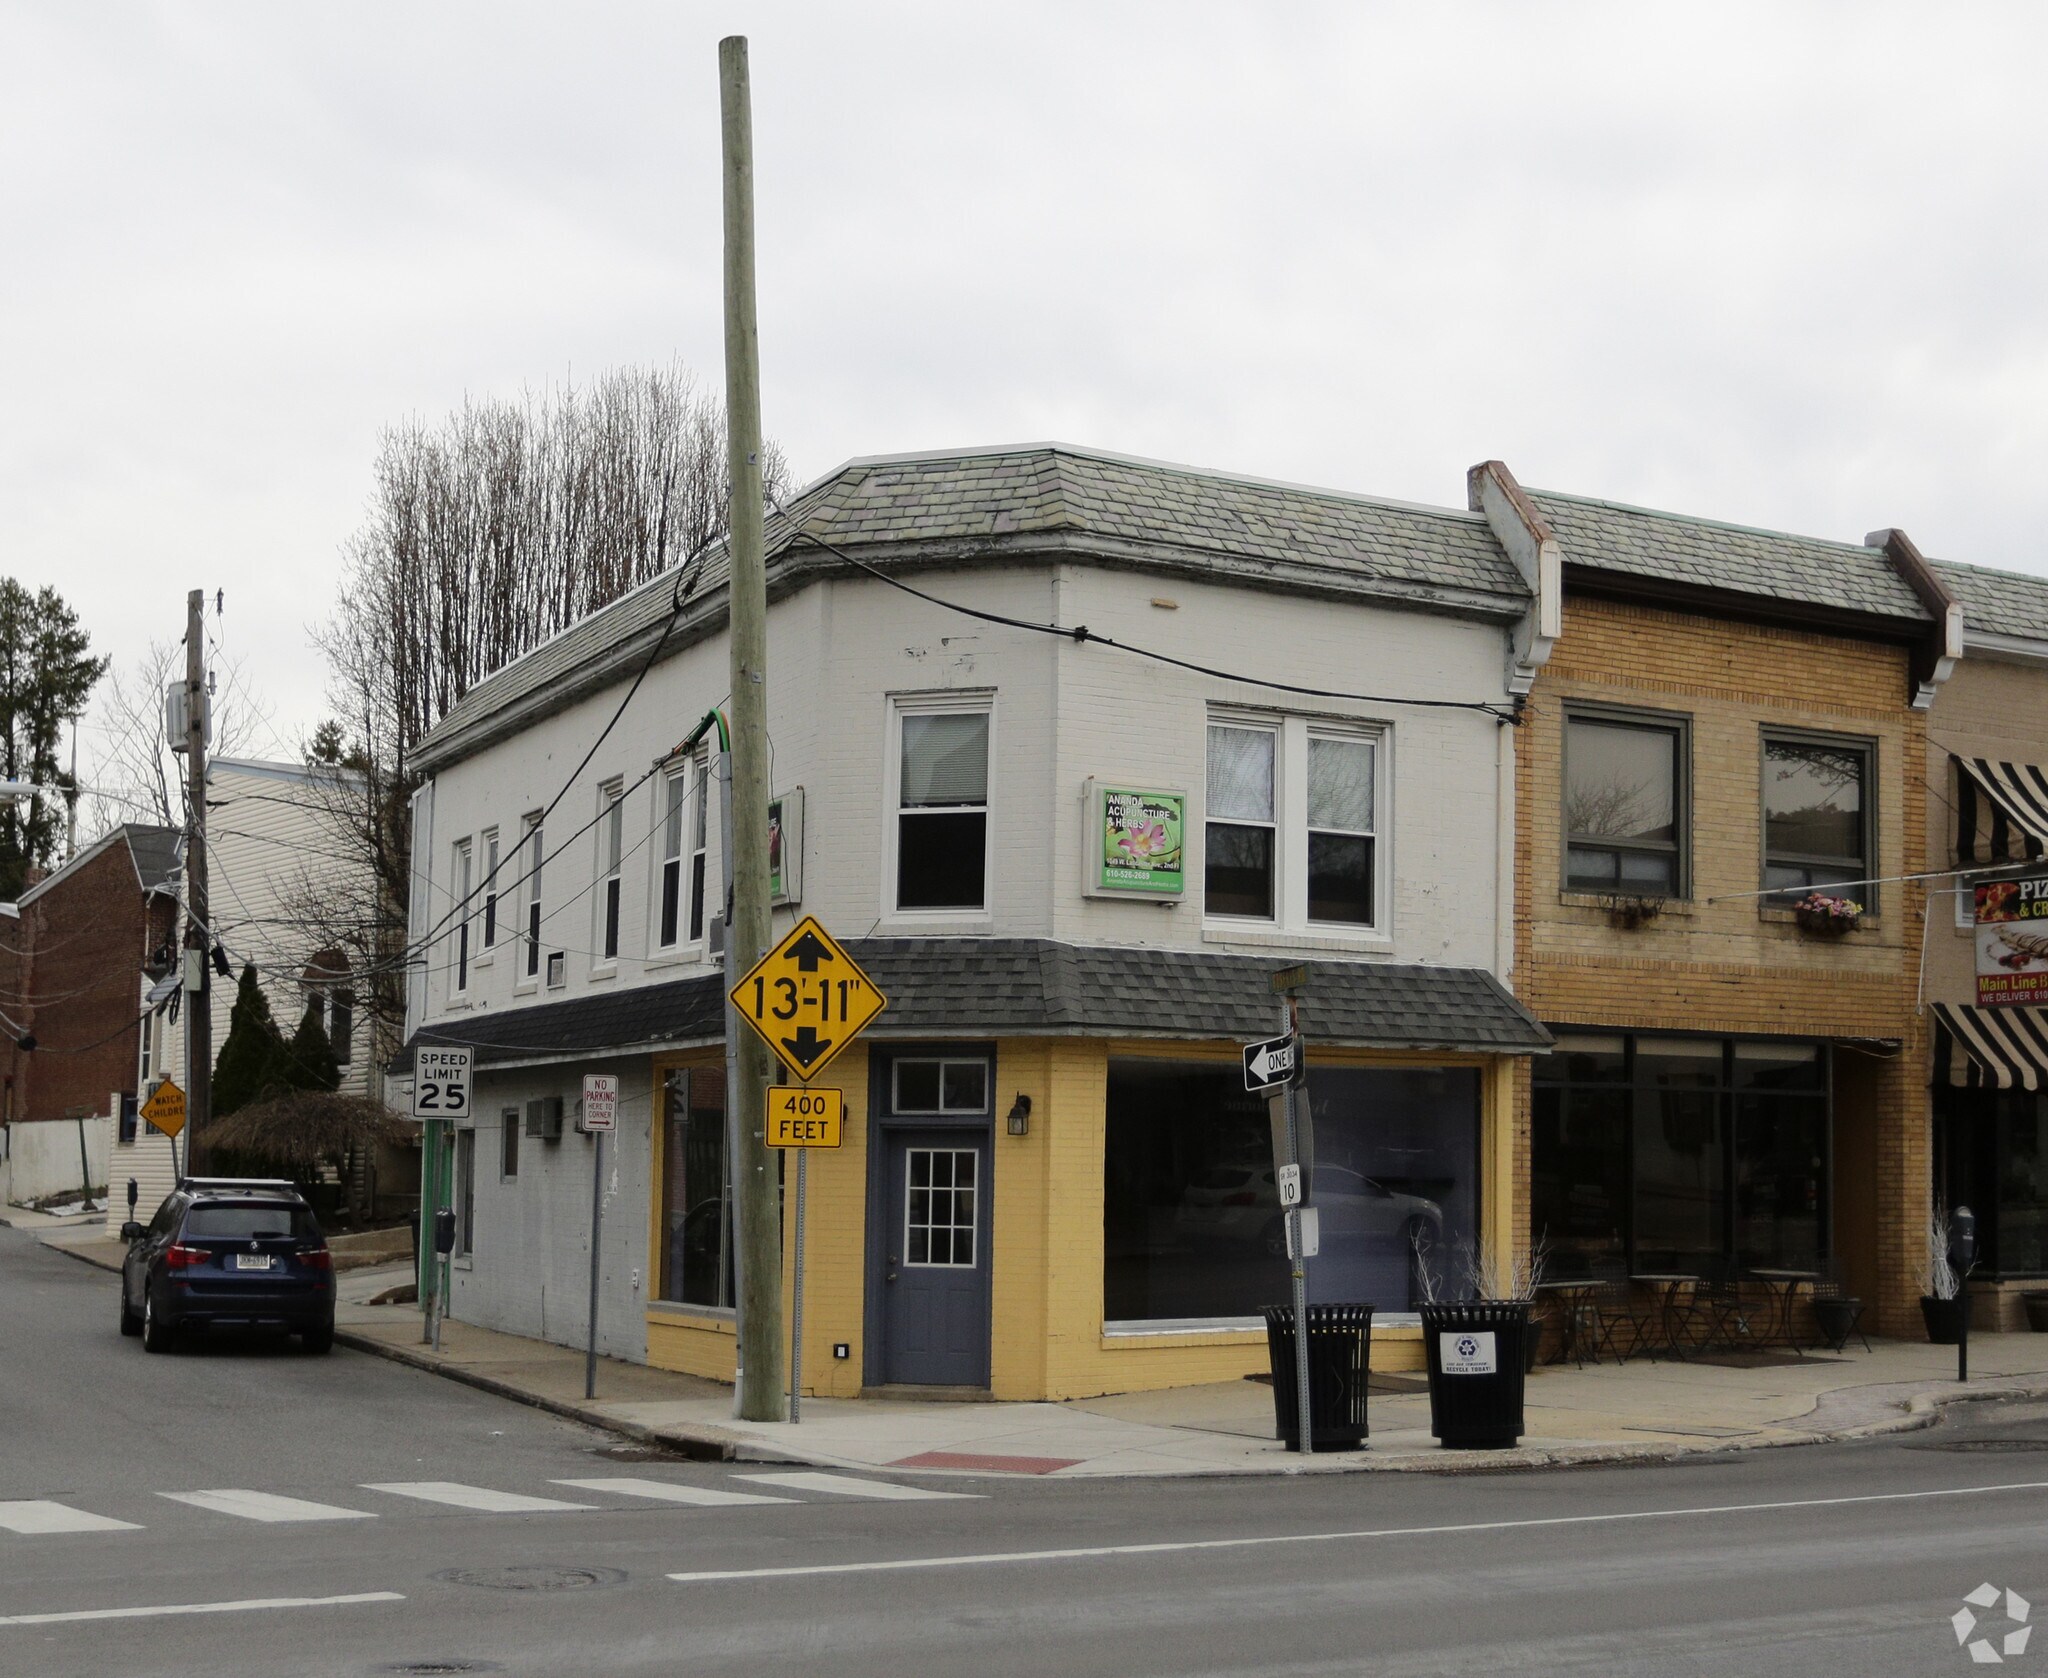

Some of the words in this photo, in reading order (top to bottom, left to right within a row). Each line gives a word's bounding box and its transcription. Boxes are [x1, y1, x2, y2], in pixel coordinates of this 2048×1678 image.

[1108, 794, 1144, 807] ANANDA
[1108, 806, 1171, 820] ACUPUNCTURE
[1107, 817, 1114, 826] &
[1115, 817, 1144, 829] HERBS
[2020, 902, 2030, 918] &
[1979, 976, 2008, 992] Main
[2011, 974, 2038, 990] Line
[1981, 993, 1994, 1003] WE
[1996, 991, 2031, 1002] DELIVER
[420, 1053, 468, 1065] SPEED
[1268, 1050, 1287, 1071] ONE
[424, 1068, 462, 1080] LIMIT
[594, 1079, 607, 1090] NO
[154, 1094, 182, 1106] WATCH
[419, 1083, 465, 1110] 25
[586, 1090, 615, 1103] PARKING
[588, 1102, 603, 1111] HERE
[605, 1103, 613, 1111] TO
[784, 1095, 826, 1115] 400
[148, 1106, 184, 1119] CHILDRE
[588, 1110, 612, 1119] CORNER
[779, 1120, 829, 1139] FEET
[1283, 1183, 1295, 1200] 10
